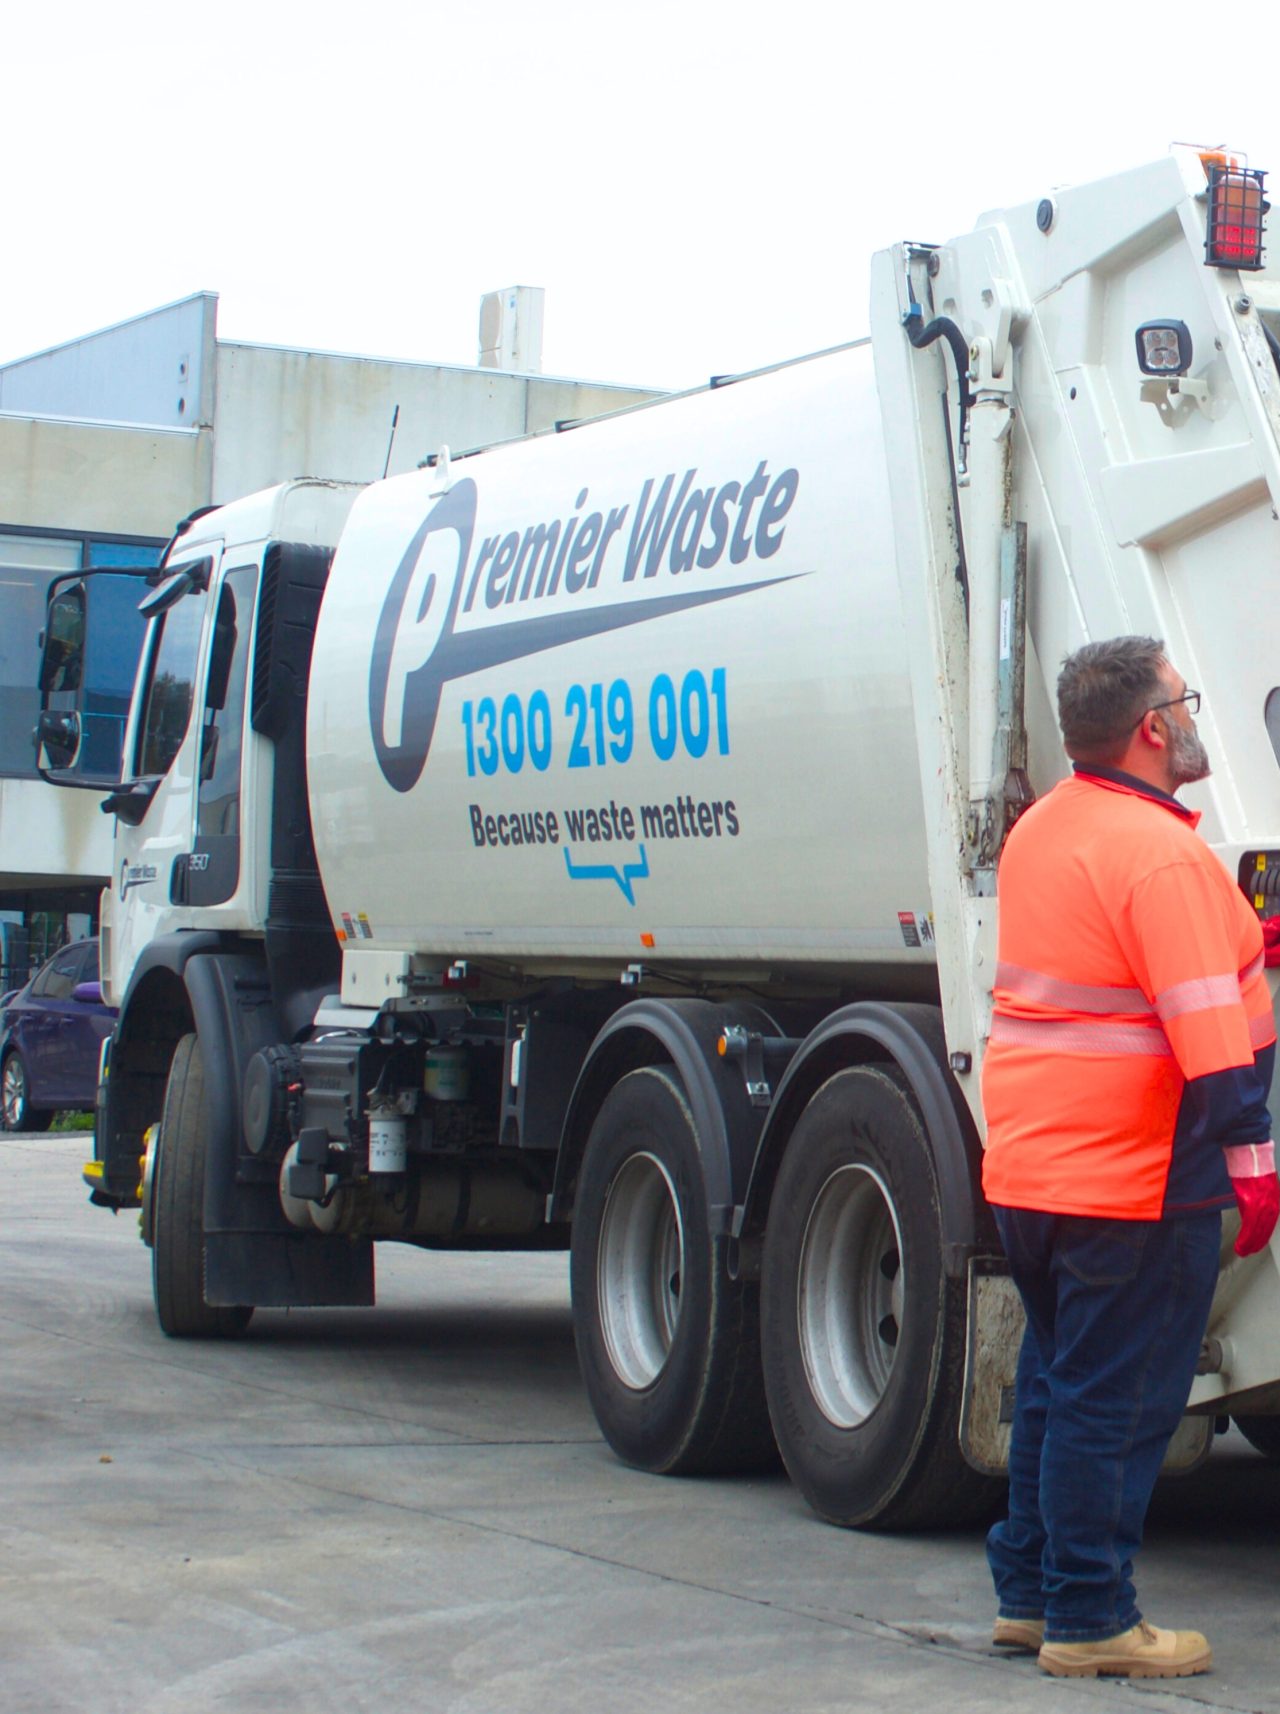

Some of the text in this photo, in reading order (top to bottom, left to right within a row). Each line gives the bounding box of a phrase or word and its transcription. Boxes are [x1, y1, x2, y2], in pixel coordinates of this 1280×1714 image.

[369, 460, 800, 792] Premier Waste
[461, 667, 730, 777] 1300 219 001
[189, 853, 209, 870] 350
[469, 796, 740, 847] Because waste matters
